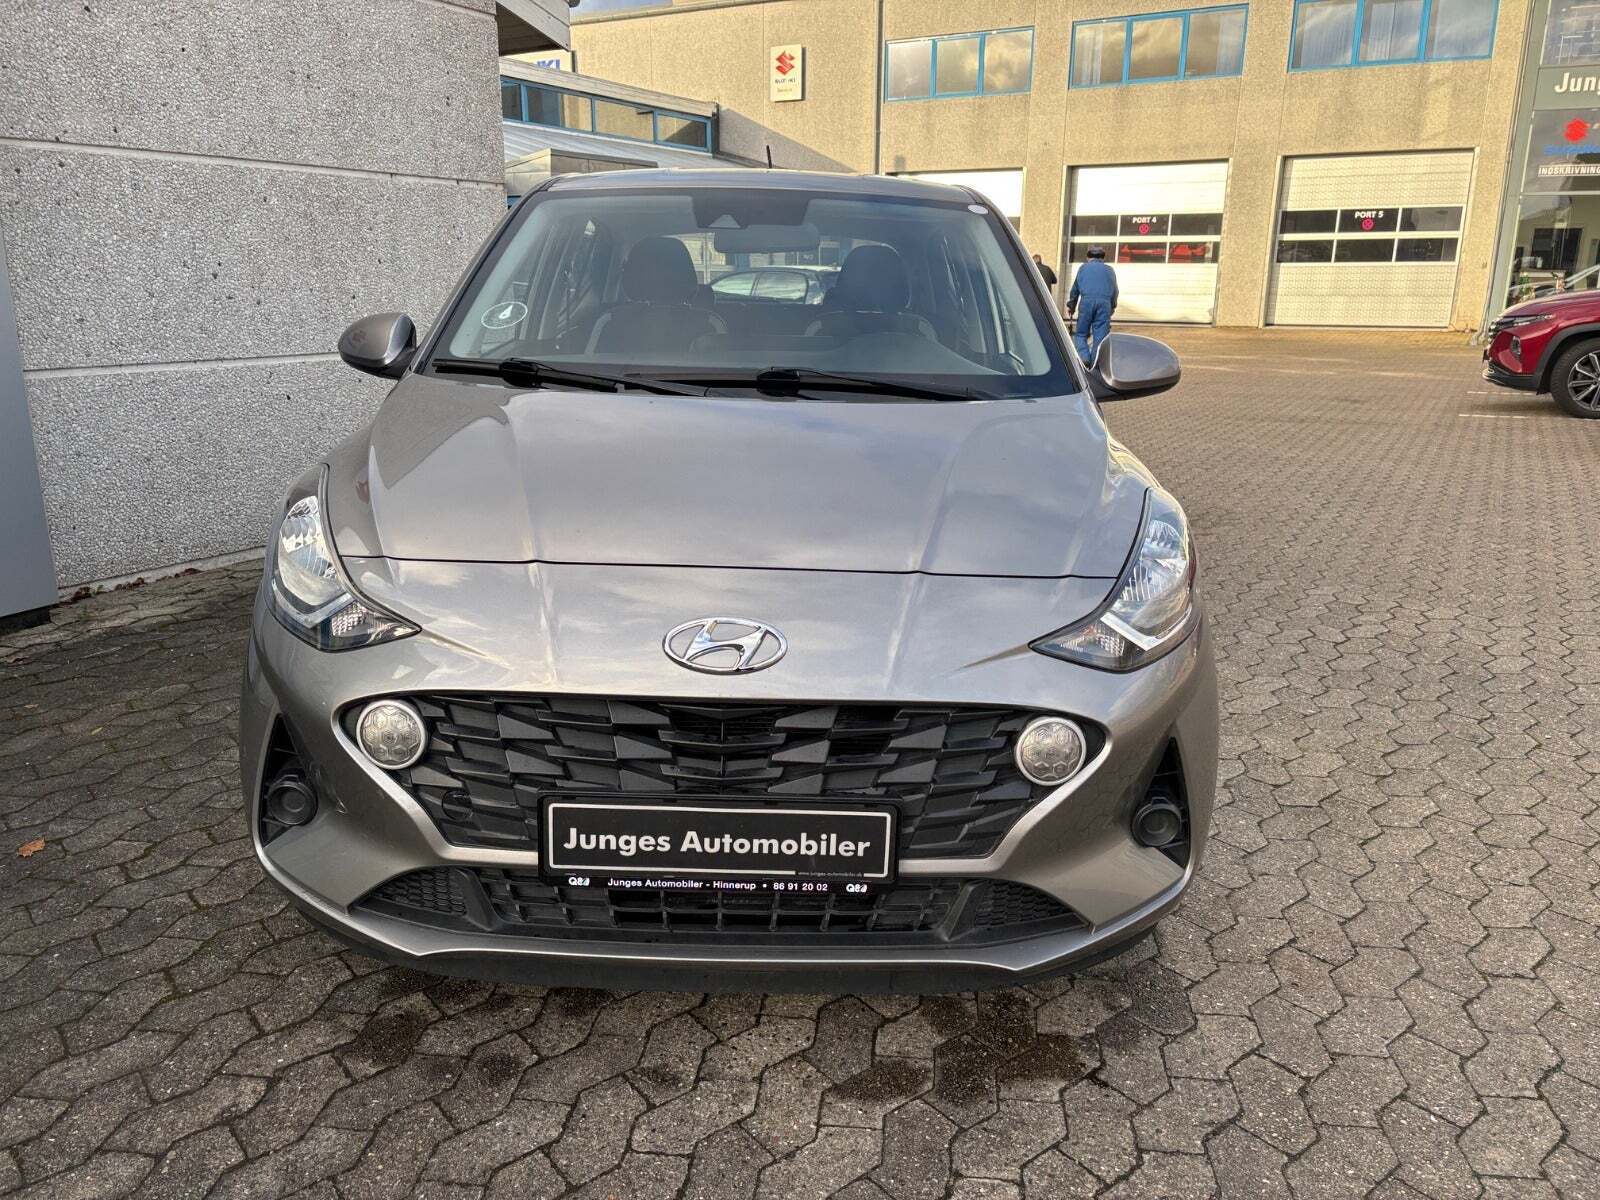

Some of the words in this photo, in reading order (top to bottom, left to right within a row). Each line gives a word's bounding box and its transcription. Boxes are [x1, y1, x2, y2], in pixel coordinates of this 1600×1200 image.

[1132, 216, 1151, 224] PORT
[1354, 211, 1376, 219] PORT
[563, 827, 672, 857] Junges
[680, 830, 871, 857] Automobiler
[607, 878, 642, 888] Junges
[645, 879, 703, 889] Automobiler
[713, 880, 756, 890] Hinnerup
[773, 882, 785, 891] 86
[788, 883, 798, 891] 91
[802, 883, 814, 891] 20
[816, 883, 828, 891] 02
